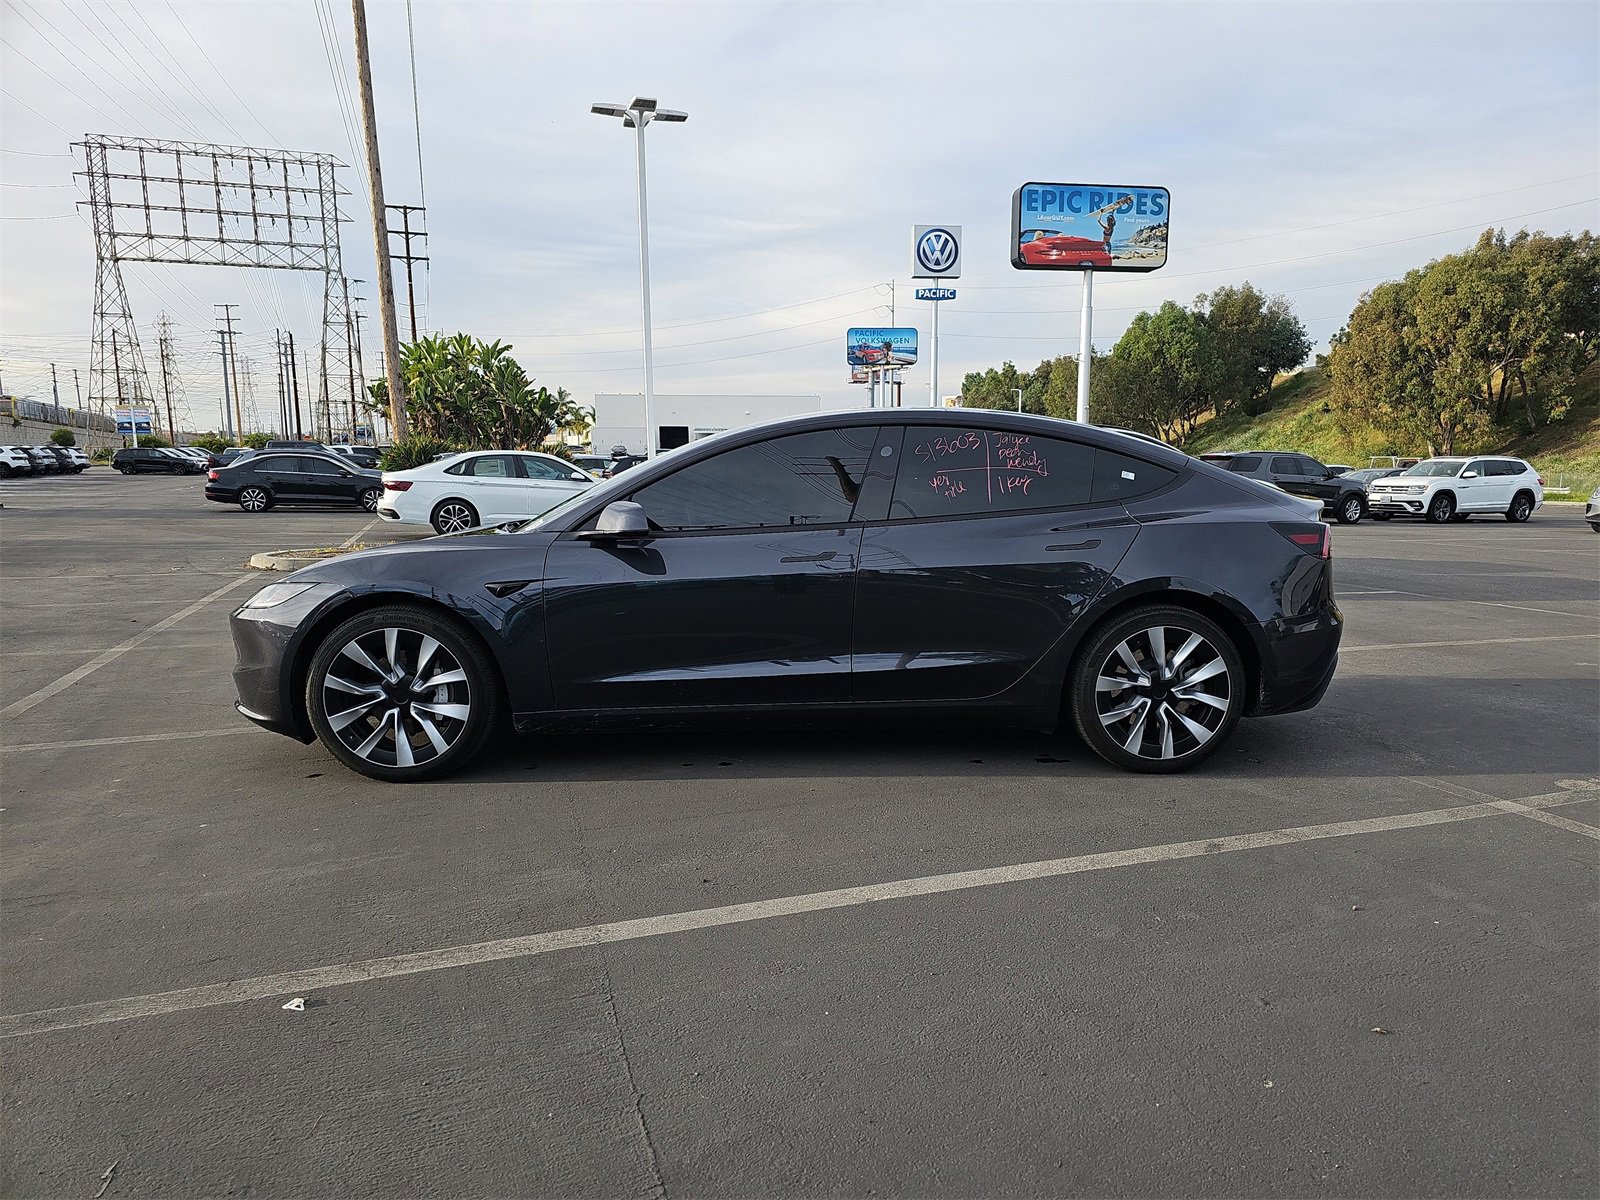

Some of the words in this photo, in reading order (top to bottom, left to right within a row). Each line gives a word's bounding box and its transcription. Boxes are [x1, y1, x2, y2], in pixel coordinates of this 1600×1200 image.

[1027, 189, 1082, 213] EPIC
[1089, 191, 1164, 216] RIDES
[918, 289, 954, 298] PACIFIC
